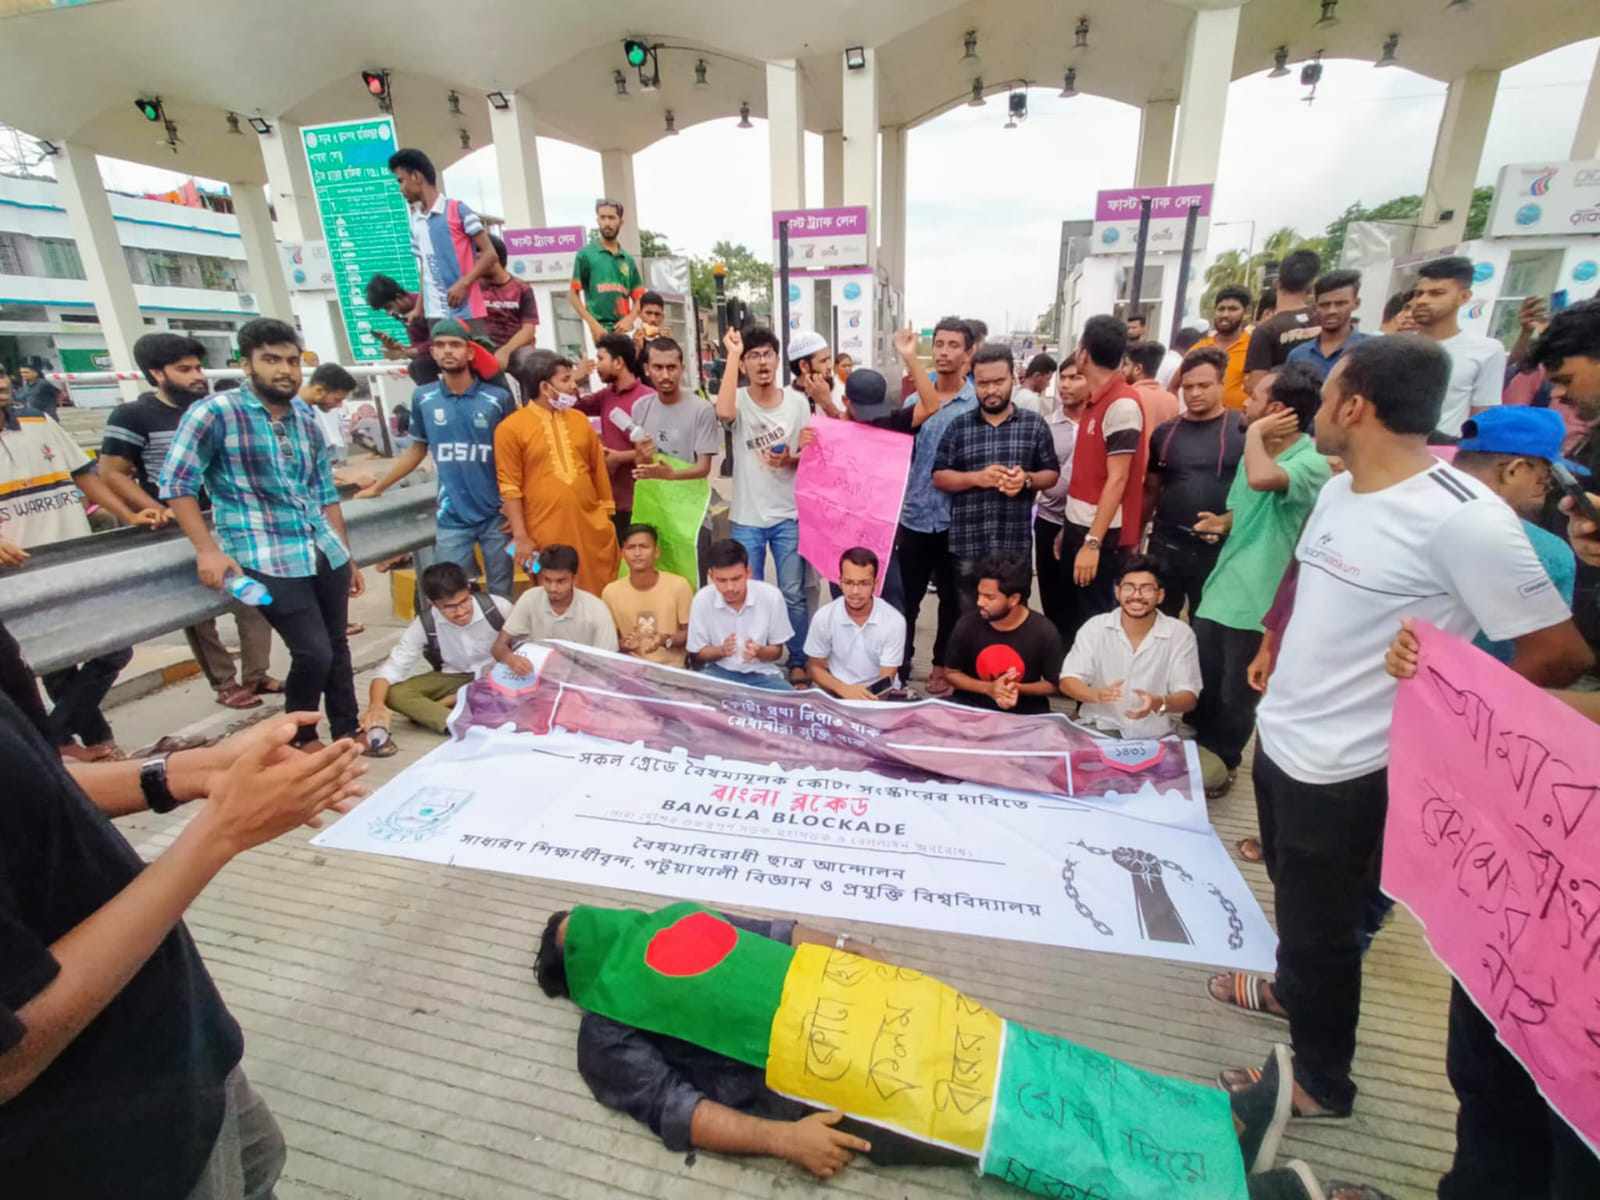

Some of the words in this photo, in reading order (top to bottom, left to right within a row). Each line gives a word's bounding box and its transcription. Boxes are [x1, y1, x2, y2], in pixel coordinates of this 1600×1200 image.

[578, 752, 624, 767] সকল
[630, 755, 678, 772] গ্রেডে
[684, 759, 789, 786] বৈষম্যমূলক
[957, 793, 1029, 809] দাবিতে
[711, 784, 781, 808] বাংলা
[790, 792, 871, 817] ব্লকেড
[661, 799, 760, 821] BANGLA
[772, 812, 907, 836] BLOCKADE
[459, 833, 527, 852] সাধারণ
[644, 857, 738, 881] পটুয়াখালী
[746, 868, 812, 890] বিজ্ঞান
[819, 880, 833, 892] ও
[842, 882, 904, 901] প্রযুক্তি
[914, 888, 1042, 917] বিশ্ববিদ্যালয়
[633, 836, 760, 864] বৈষম্যবিরোধী
[767, 854, 804, 870] ছাত্র
[812, 858, 905, 880] আন্দোলন
